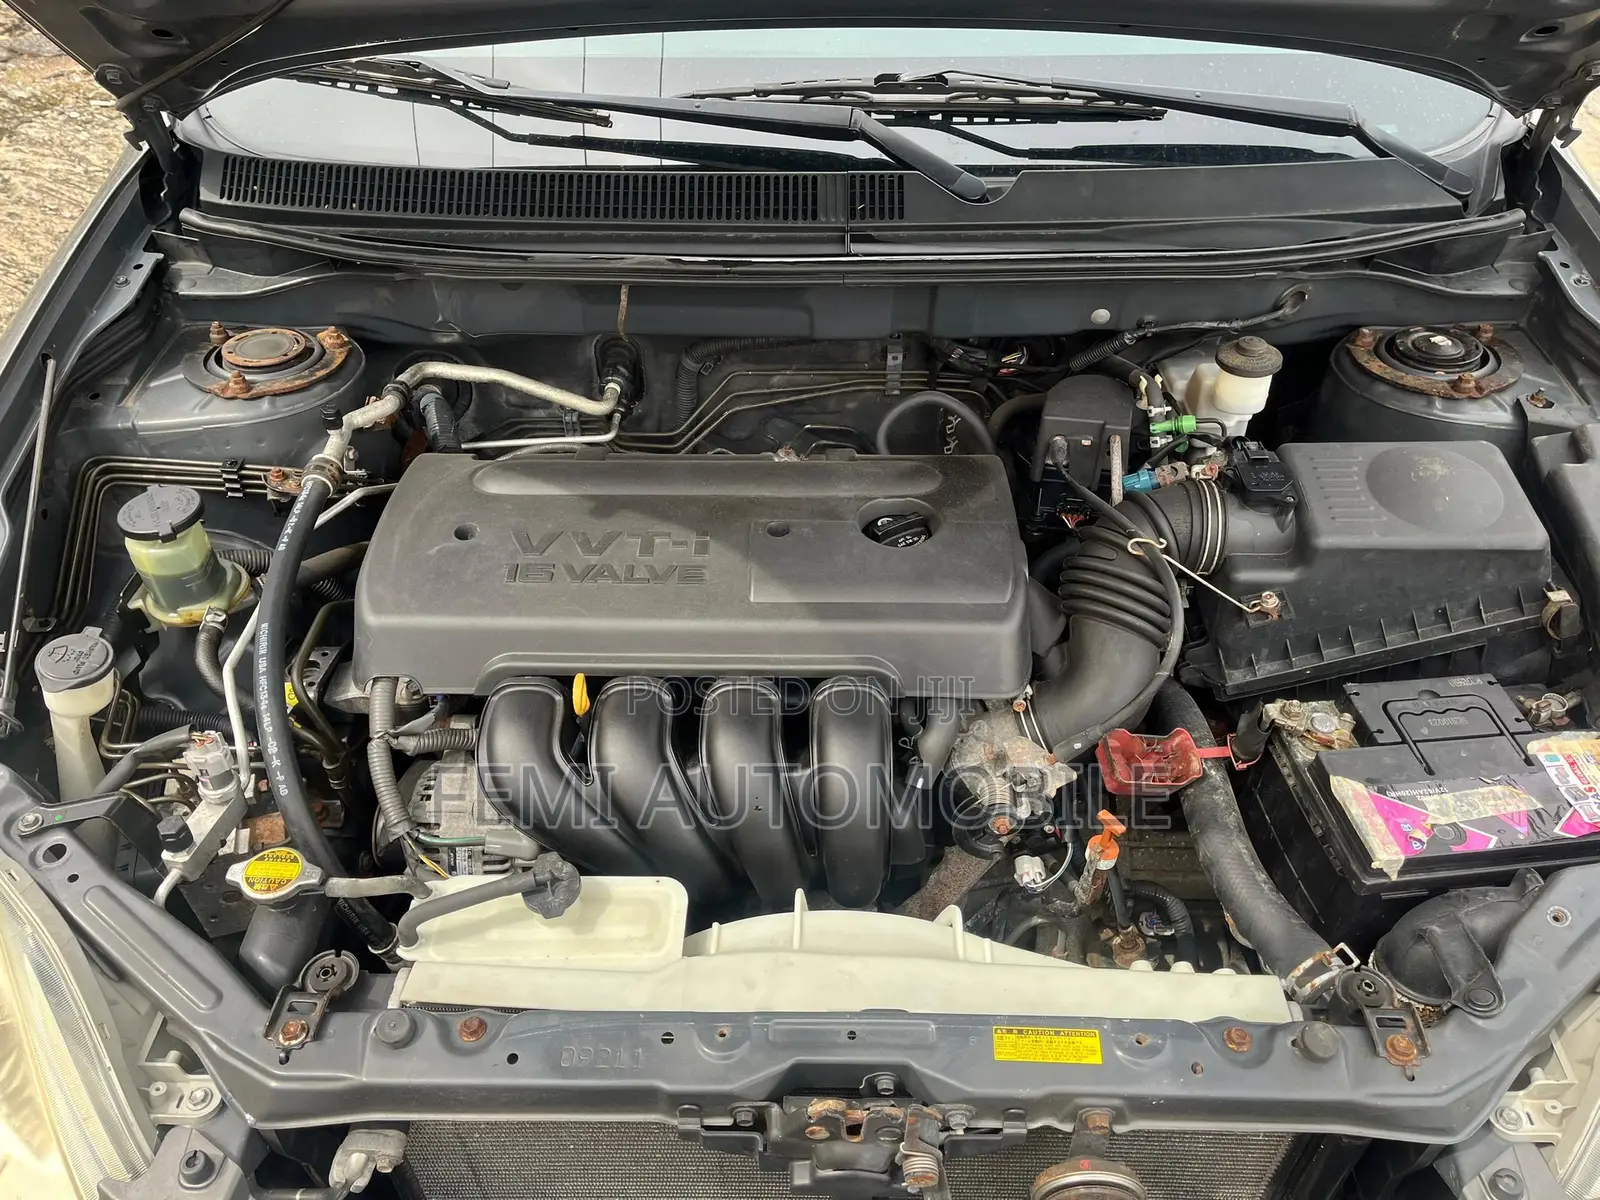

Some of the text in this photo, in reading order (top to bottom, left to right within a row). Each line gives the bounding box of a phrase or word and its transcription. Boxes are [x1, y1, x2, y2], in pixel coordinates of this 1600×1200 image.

[504, 562, 708, 585] 16 VALVE
[258, 656, 267, 674] USA
[247, 877, 288, 885] CAUTION
